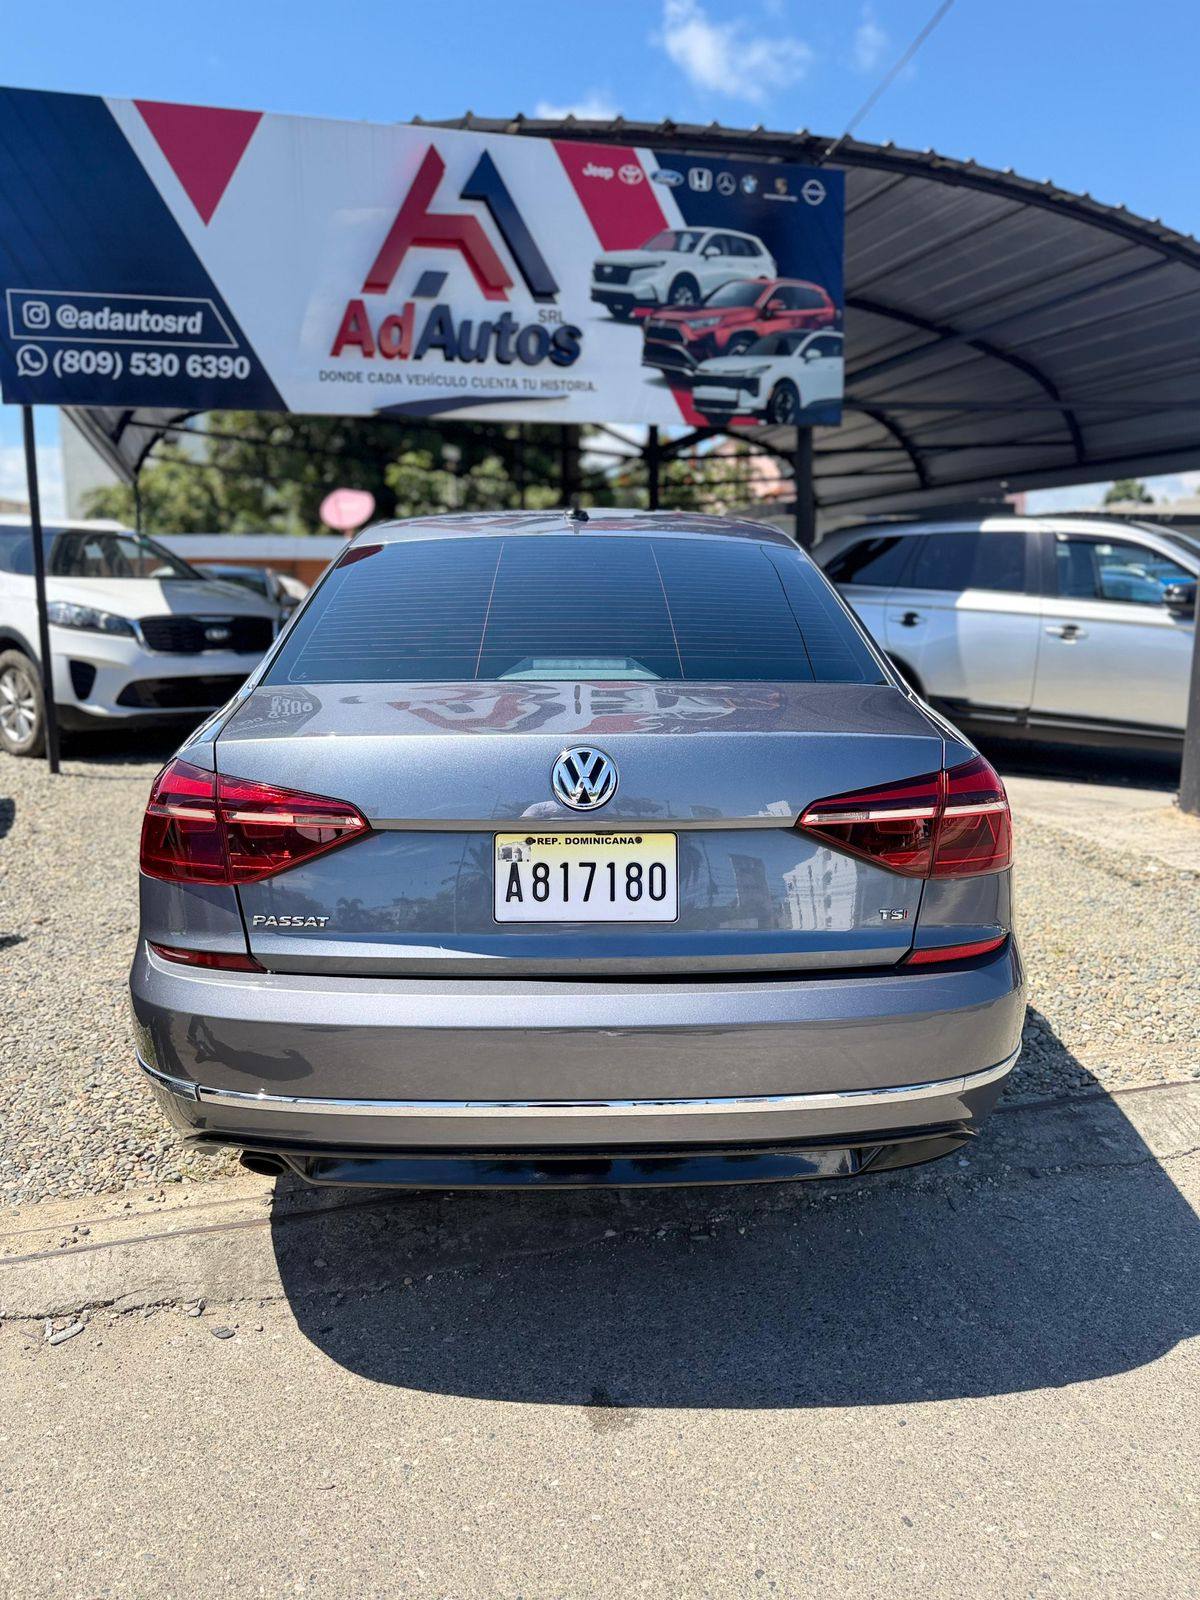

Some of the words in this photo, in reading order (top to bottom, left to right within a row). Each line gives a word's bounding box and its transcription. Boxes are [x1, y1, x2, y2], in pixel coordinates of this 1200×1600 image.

[56, 304, 203, 334] @adautosrd
[538, 309, 566, 325] SRL
[329, 298, 583, 367] AdAutos
[52, 349, 123, 380] (809)
[129, 353, 180, 376] 530
[186, 356, 250, 379] 6390
[318, 370, 363, 384] DONDE
[367, 372, 402, 385] CADA
[406, 371, 467, 389] VEHÍCULO
[471, 377, 518, 391] CUENTA
[522, 379, 537, 391] TU
[540, 380, 598, 392] HISTORIA.
[537, 837, 561, 845] REP.
[565, 837, 634, 845] DOMINICANA
[505, 862, 667, 902] A817180
[252, 915, 330, 927] PASSAT
[879, 909, 909, 920] TSI
